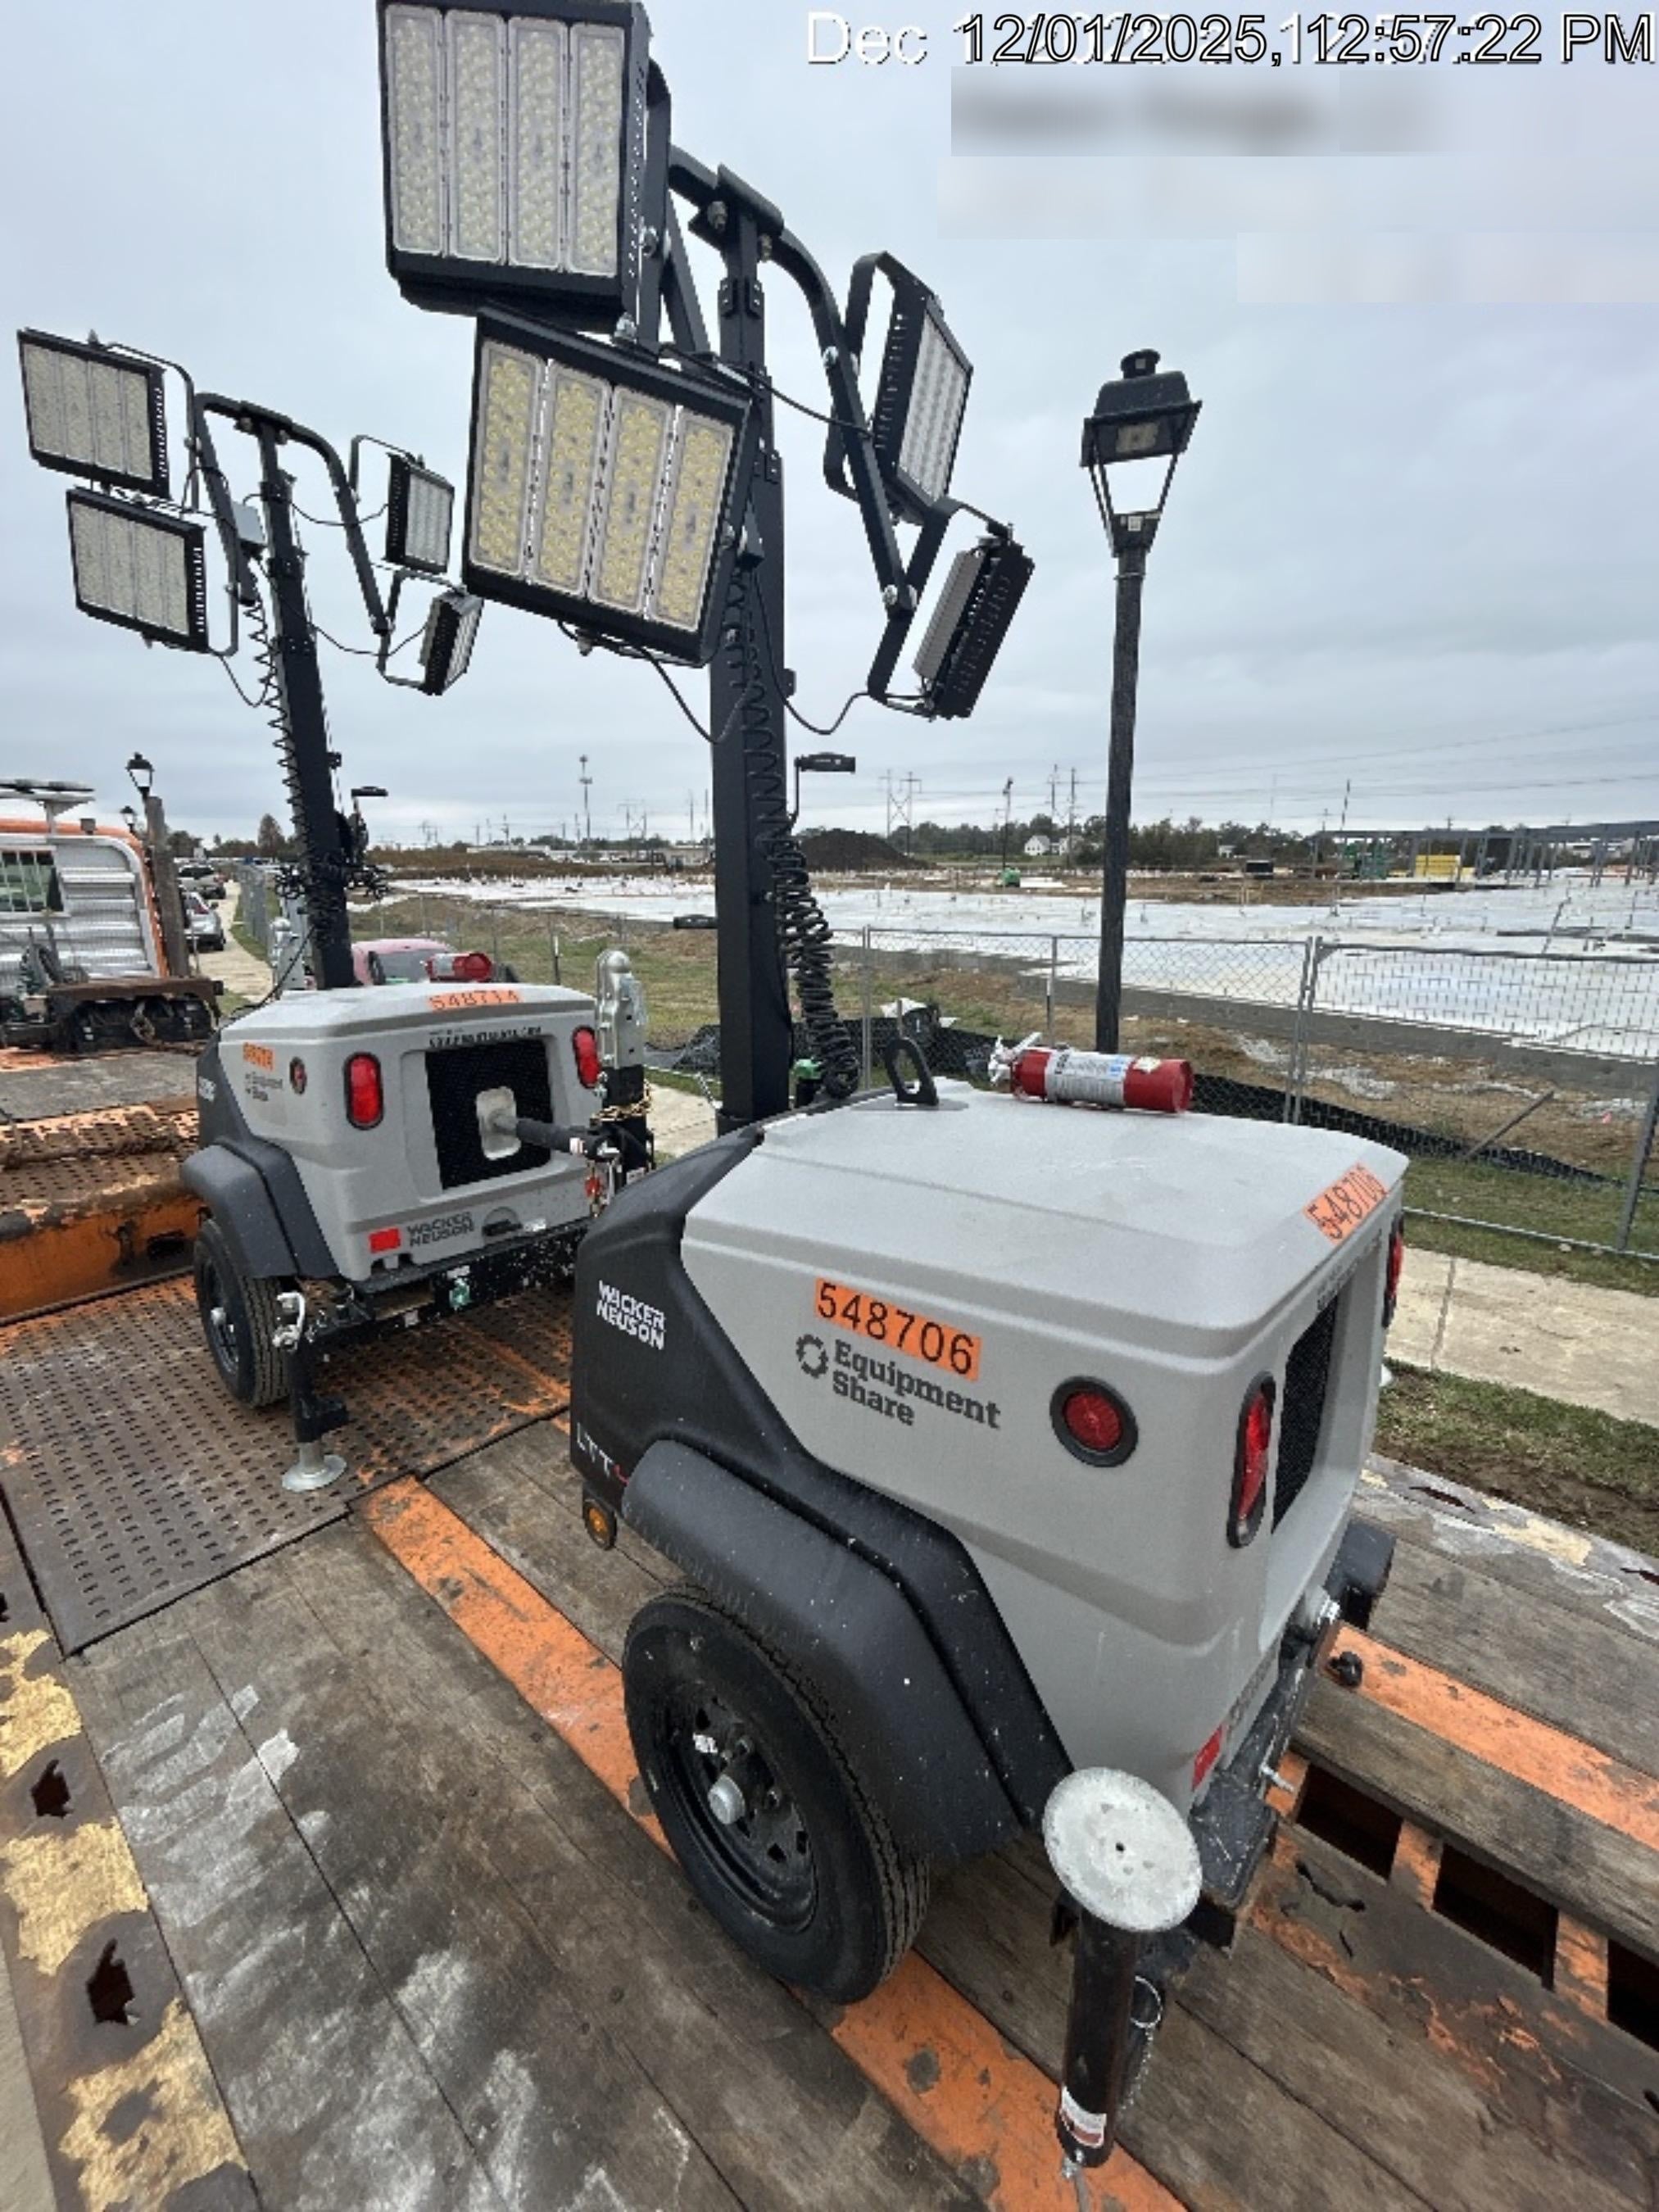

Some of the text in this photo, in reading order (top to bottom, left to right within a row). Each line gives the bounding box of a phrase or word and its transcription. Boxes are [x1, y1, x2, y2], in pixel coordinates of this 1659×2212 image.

[596, 1299, 665, 1351] NEUSON
[598, 1280, 665, 1330] WACKER
[818, 1281, 974, 1376] 548706
[832, 1369, 915, 1426] Share
[833, 1338, 1001, 1430] Equipment
